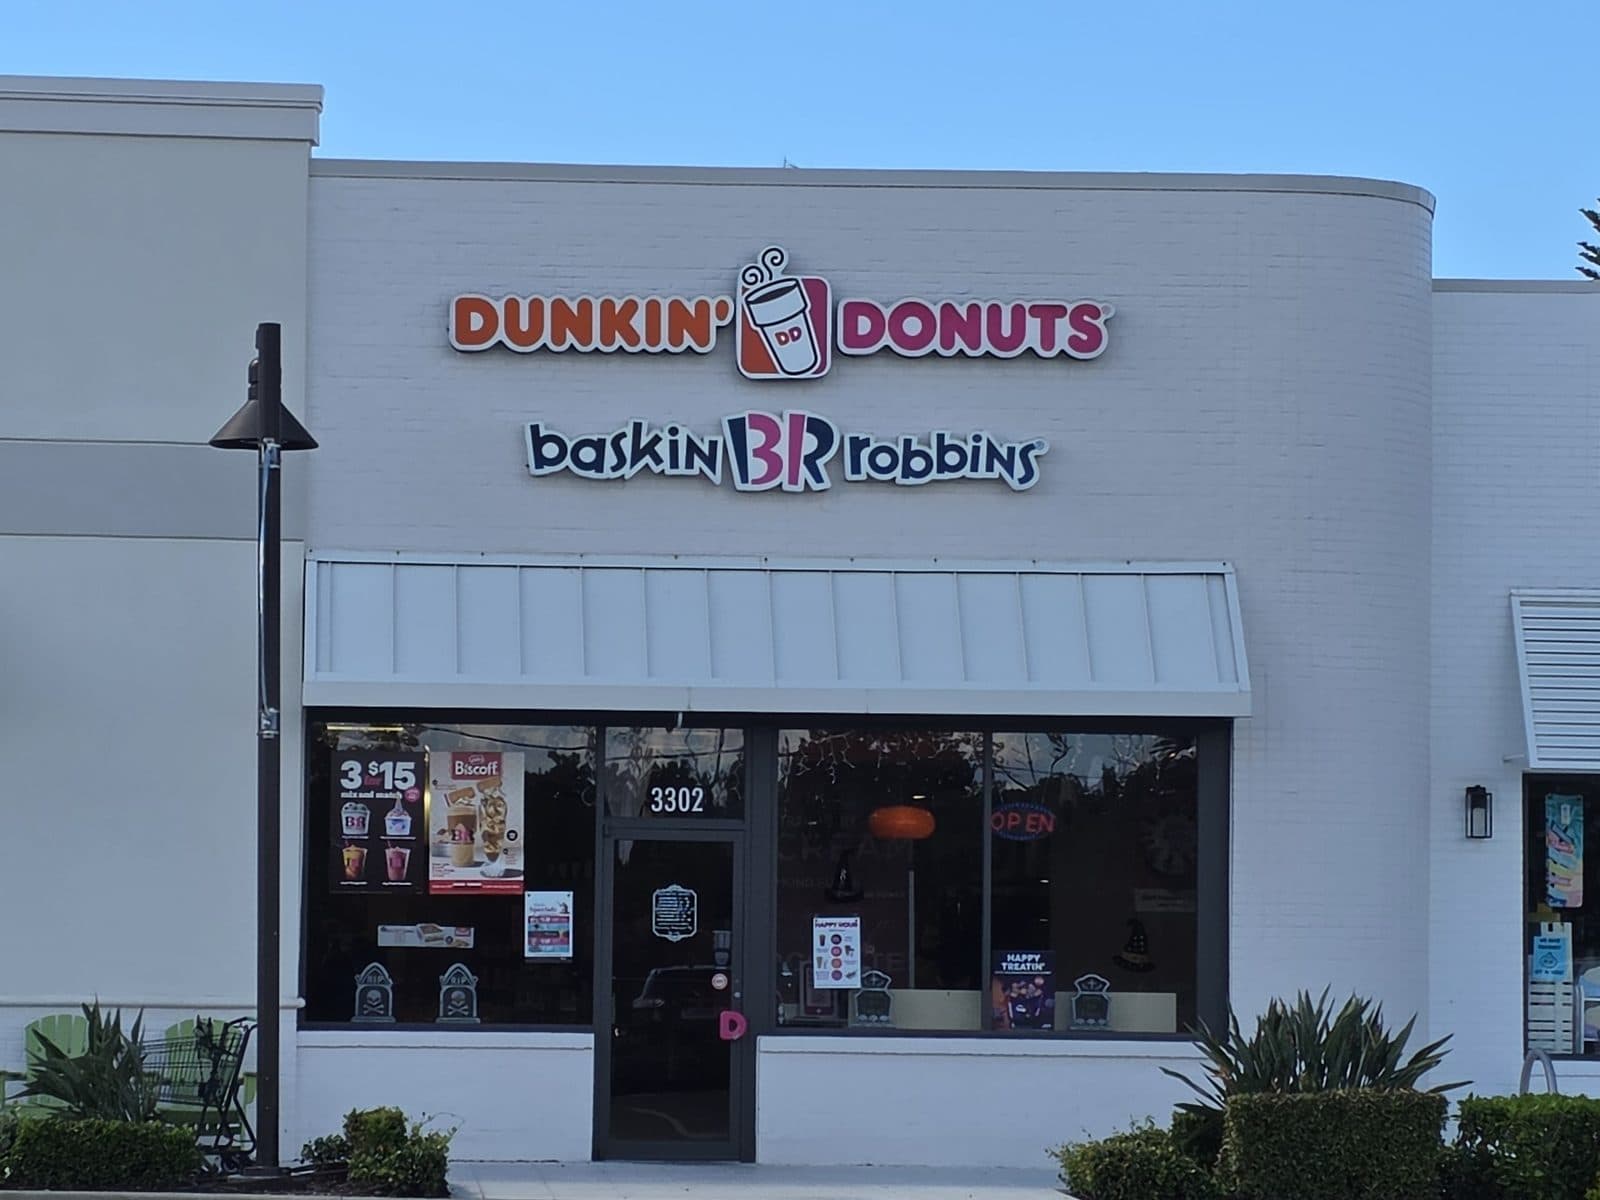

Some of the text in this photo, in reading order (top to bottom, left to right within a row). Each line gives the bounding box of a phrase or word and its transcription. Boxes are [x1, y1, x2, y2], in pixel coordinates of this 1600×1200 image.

[454, 297, 1103, 354] DUNKIN' DONUTS
[774, 326, 802, 346] DD
[529, 413, 1037, 486] baskin BR robbins
[340, 760, 362, 789] 3
[368, 761, 416, 790] $15
[455, 761, 498, 775] Biscoff
[650, 787, 704, 812] 3302
[991, 811, 1054, 832] OPEN
[1007, 954, 1041, 962] HAPPY
